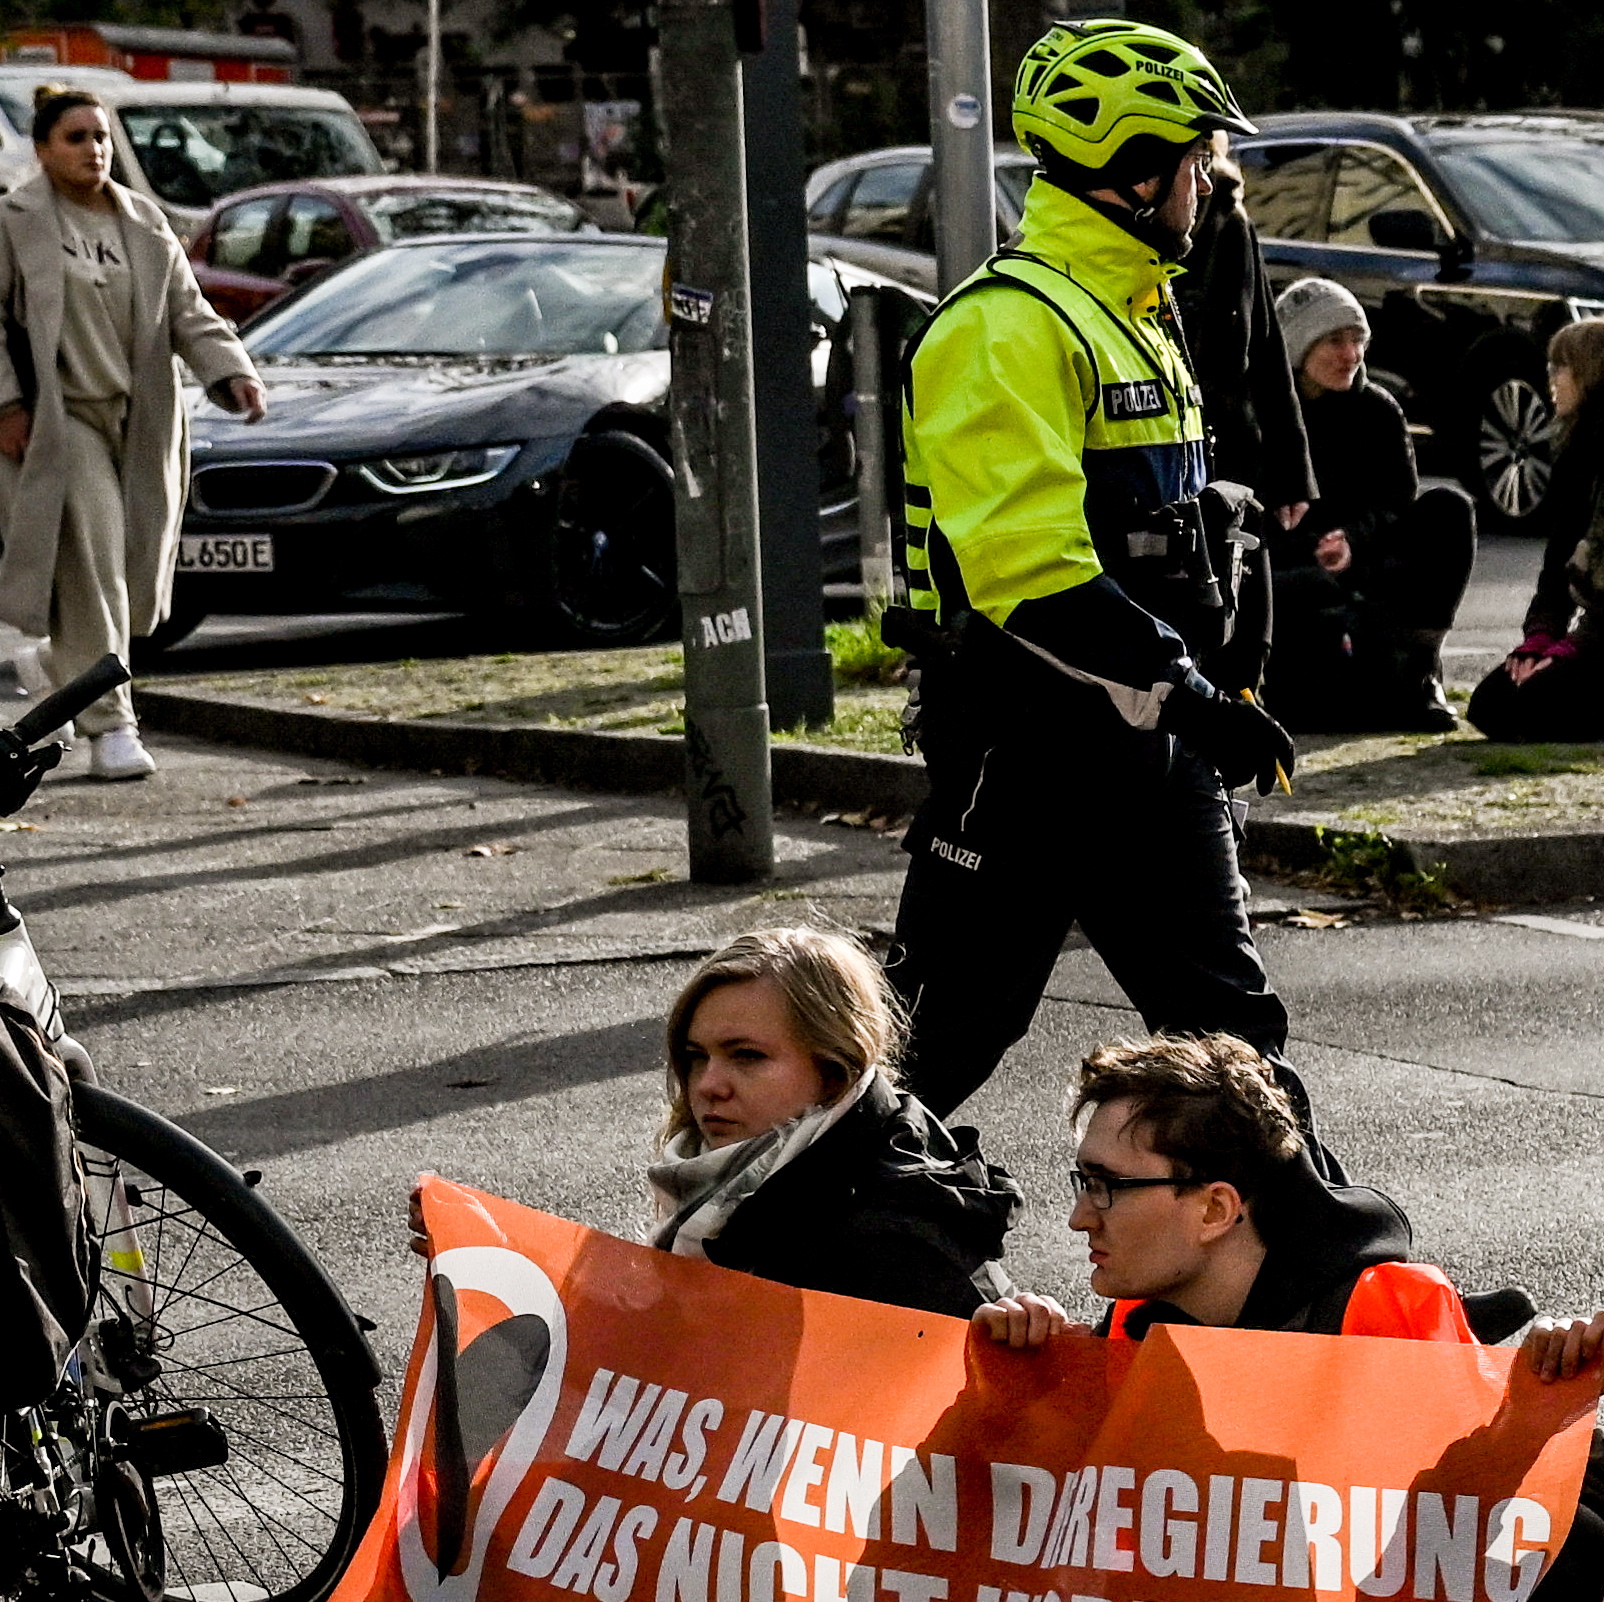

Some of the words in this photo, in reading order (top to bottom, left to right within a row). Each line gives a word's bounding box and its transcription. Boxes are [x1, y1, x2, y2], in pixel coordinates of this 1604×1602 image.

[1135, 60, 1185, 84] POLIZEI
[930, 836, 982, 871] POLIZEI
[564, 1367, 724, 1503] WAS,
[717, 1410, 957, 1552] WENN
